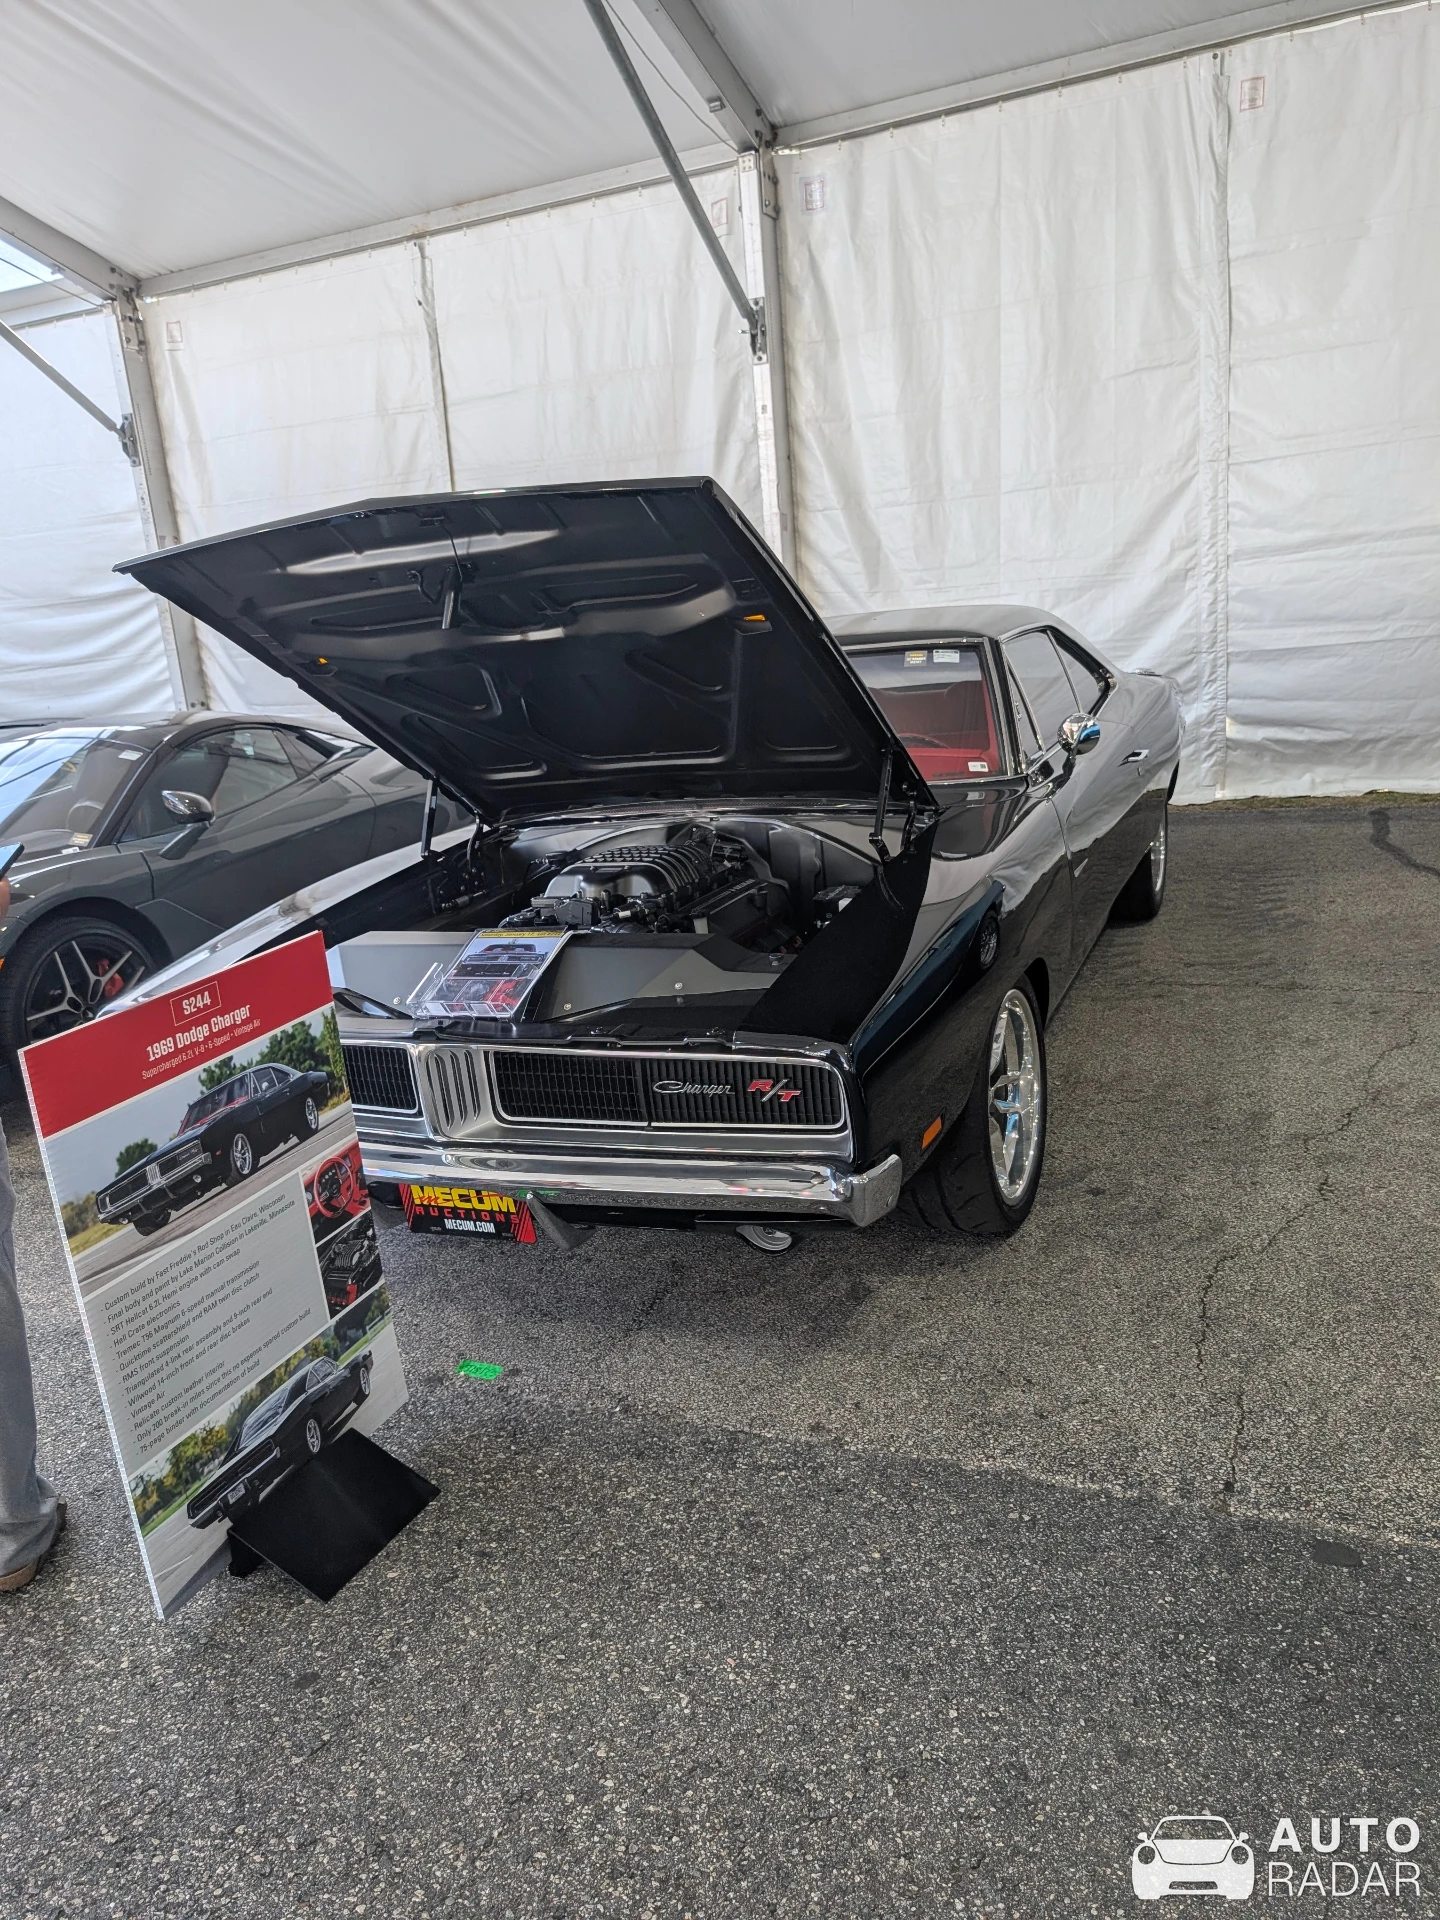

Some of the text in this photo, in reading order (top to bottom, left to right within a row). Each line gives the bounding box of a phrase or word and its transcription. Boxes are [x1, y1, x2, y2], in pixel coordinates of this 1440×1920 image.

[147, 1005, 250, 1061] 1969 Dodge Charger
[183, 991, 211, 1014] S244
[142, 1055, 182, 1079] Supercharged
[208, 1032, 230, 1049] 6-Speed
[233, 1023, 253, 1036] Vintage
[653, 1079, 803, 1102] Charger R/T
[410, 1184, 517, 1213] MECUM
[415, 1206, 520, 1224] AUCTIONS
[444, 1219, 496, 1233] MECUM.COM
[104, 1292, 130, 1310] Custom
[130, 1280, 146, 1295] build
[155, 1267, 169, 1279] Fast
[169, 1250, 197, 1270] Freddie's
[197, 1241, 209, 1253] Rod
[209, 1233, 224, 1245] Shop
[230, 1223, 241, 1232] Eau
[259, 1194, 285, 1213] Wisconsin
[107, 1308, 124, 1323] Final
[124, 1299, 140, 1312] body
[142, 1289, 154, 1302] and
[155, 1280, 170, 1295] paint
[179, 1266, 193, 1278] Lake
[194, 1252, 214, 1268] Marion
[215, 1237, 238, 1254] Collision
[110, 1321, 123, 1335] SRT
[125, 1307, 148, 1326] Hellcat
[162, 1289, 177, 1302] Hemi
[179, 1276, 198, 1291] engine
[199, 1266, 212, 1278] with
[213, 1258, 224, 1269] cam
[225, 1248, 240, 1261] swap
[116, 1341, 140, 1359] Tremec
[154, 1314, 180, 1334] Magnum
[181, 1296, 205, 1316] 6-speed
[205, 1282, 225, 1300] manual
[226, 1261, 259, 1286] transmission
[119, 1273, 260, 1371] Quicktime scattershield and RAM twin disc clutch
[113, 1301, 180, 1347] Hell Crate electronics
[125, 1364, 164, 1394] Triangulated
[182, 1344, 194, 1355] rear
[196, 1325, 222, 1346] assembly
[223, 1315, 233, 1327] and
[251, 1296, 262, 1307] rear
[262, 1287, 273, 1299] end
[122, 1335, 189, 1383] RMS front suspension
[128, 1318, 250, 1406] Wilwood 14-inch front and rear disc brakes
[137, 1430, 151, 1442] Only
[152, 1419, 163, 1431] 200
[164, 1401, 188, 1422] break-in
[189, 1389, 205, 1403] miles
[205, 1377, 220, 1391] since
[221, 1369, 232, 1379] this
[263, 1331, 280, 1348] spared
[281, 1318, 298, 1335] custom
[299, 1308, 311, 1321] build
[131, 1391, 165, 1418] Vintage Air
[134, 1361, 225, 1430] Relicate custom leather interior
[140, 1432, 165, 1453] 75-page
[165, 1417, 184, 1434] binder
[185, 1407, 199, 1419] with
[199, 1376, 240, 1409] documentation
[247, 1359, 260, 1373] build
